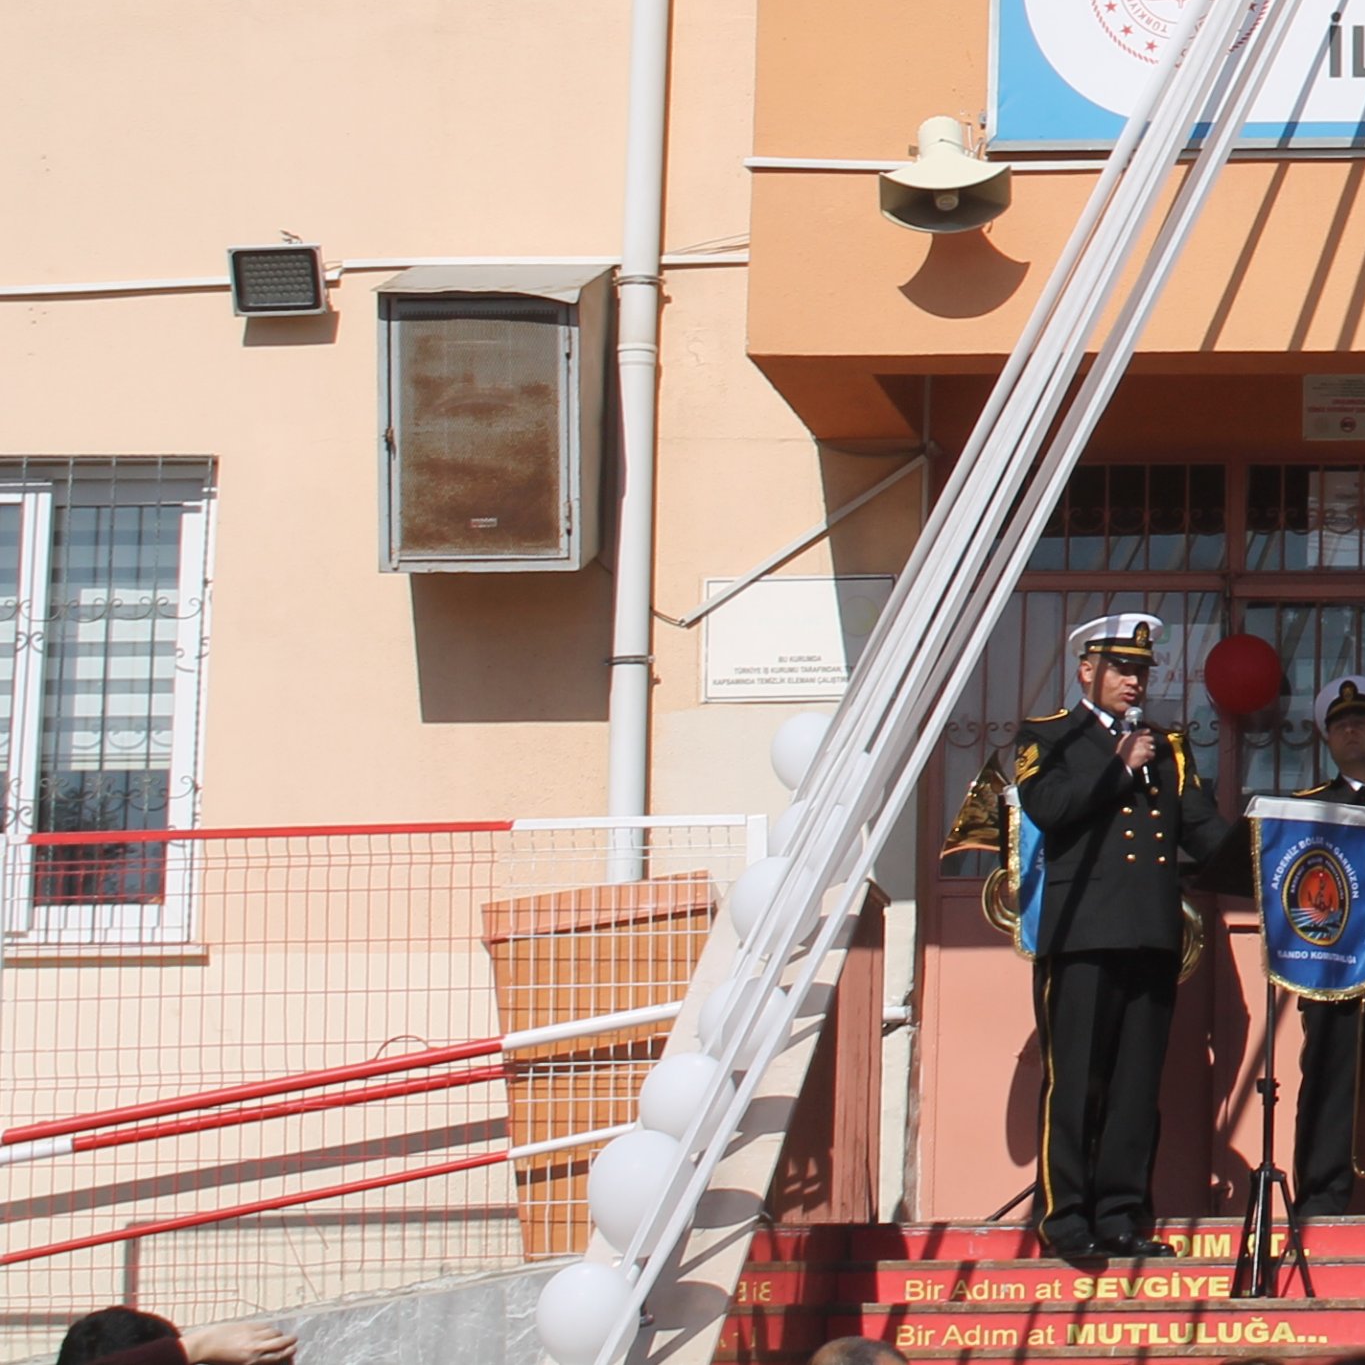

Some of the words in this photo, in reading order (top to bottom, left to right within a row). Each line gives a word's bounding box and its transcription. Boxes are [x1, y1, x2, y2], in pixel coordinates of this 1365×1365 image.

[1271, 844, 1300, 890] AKDENİZ
[1333, 846, 1360, 900] GARNİZON
[1153, 1233, 1231, 1258] DIM
[905, 1279, 944, 1302] Bir
[951, 1279, 1026, 1301] Adım
[1034, 1279, 1062, 1300] at
[896, 1324, 935, 1347] Bir
[941, 1324, 1018, 1346] Adım
[1027, 1324, 1055, 1346] at
[1066, 1317, 1328, 1346] MUTLULUĞA...
